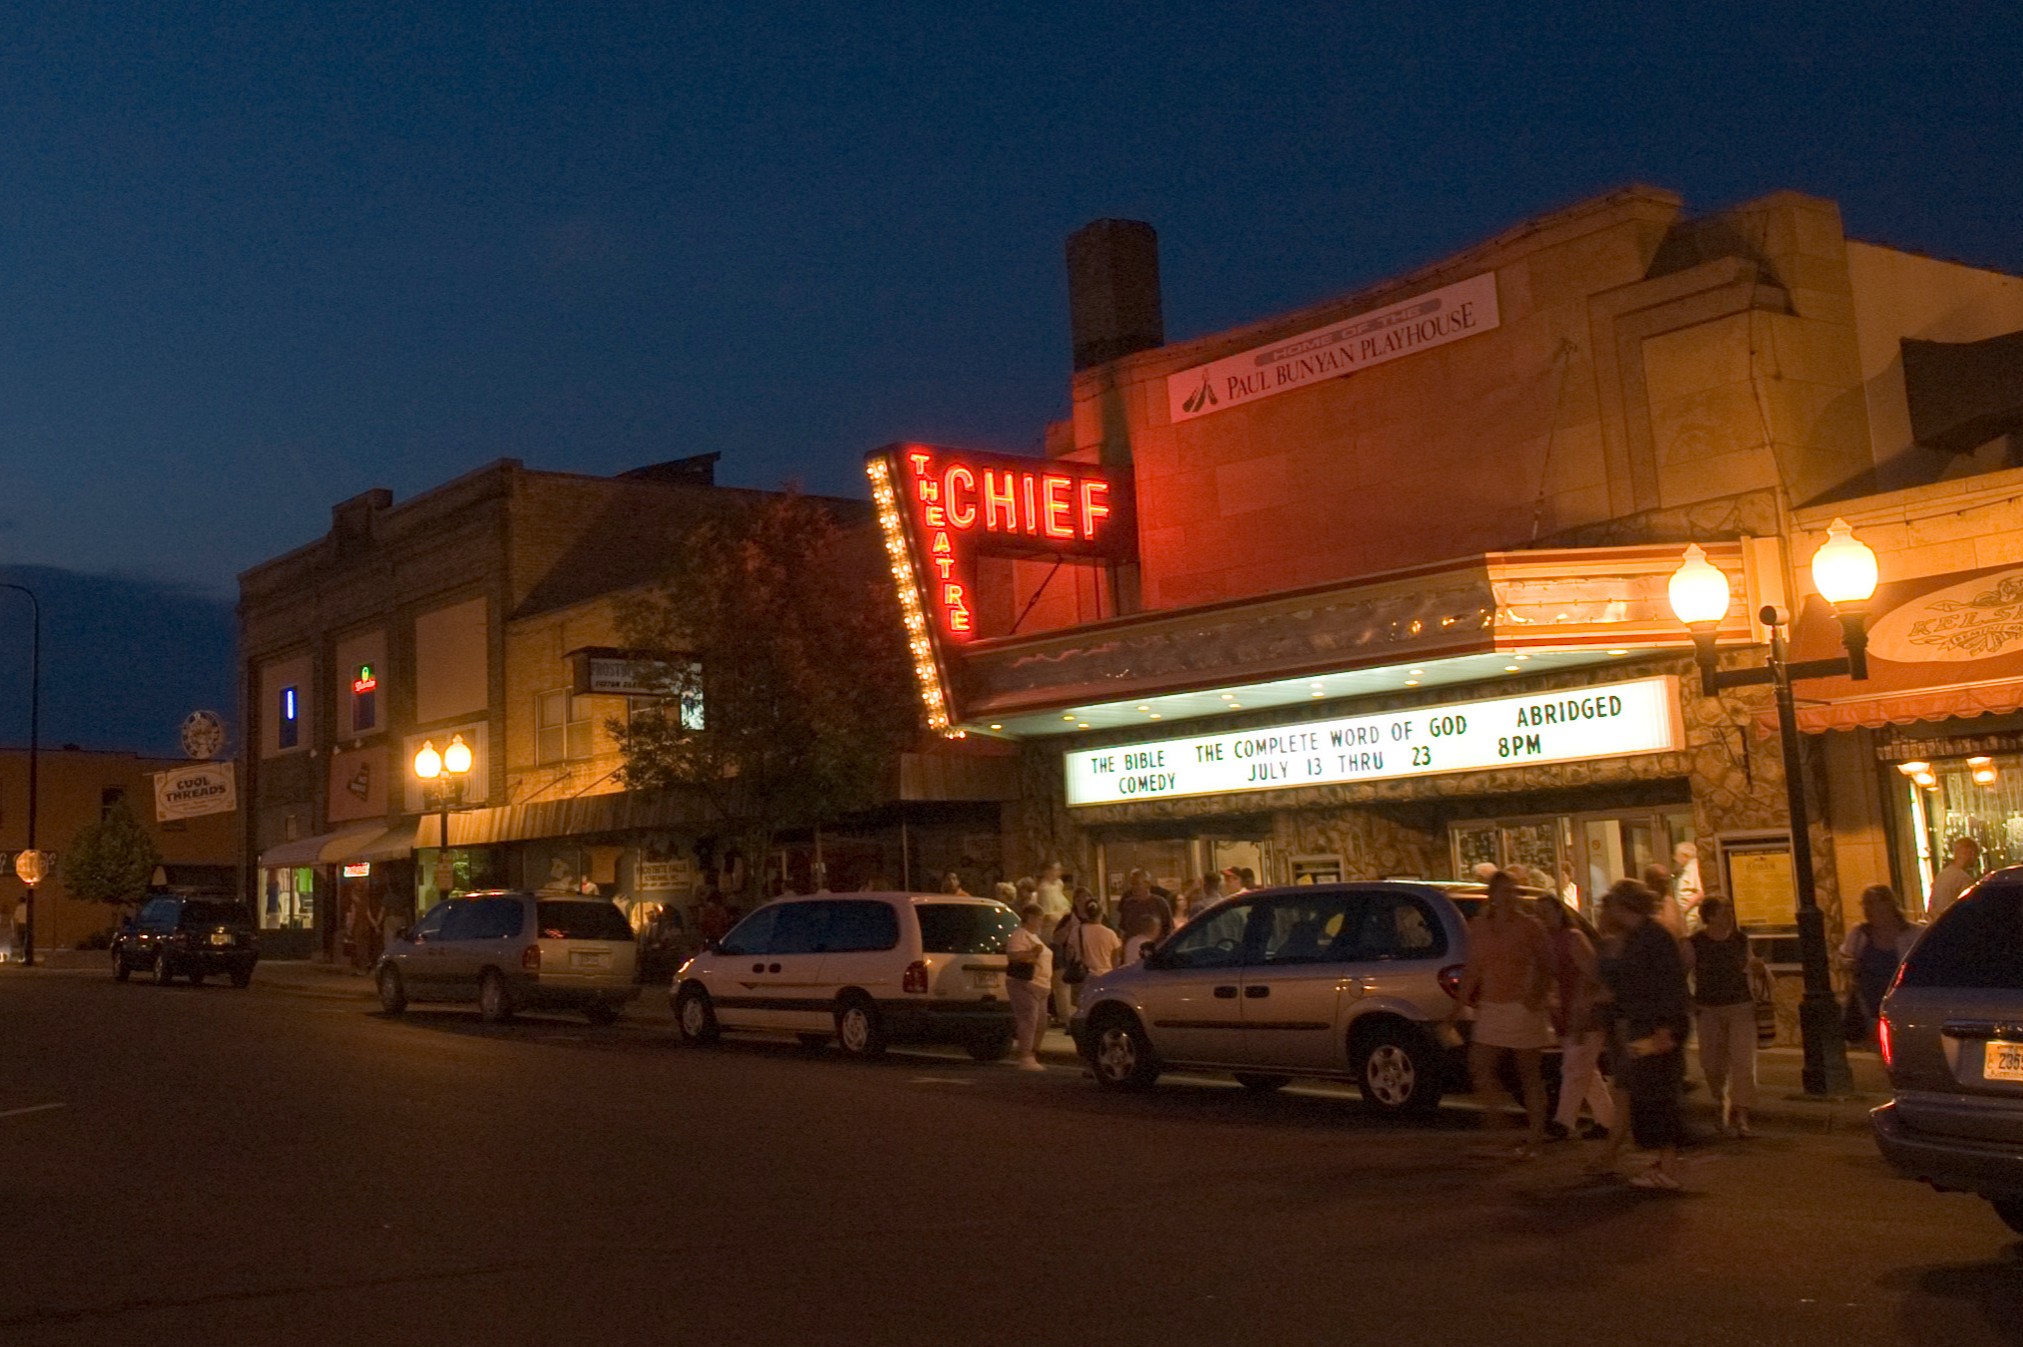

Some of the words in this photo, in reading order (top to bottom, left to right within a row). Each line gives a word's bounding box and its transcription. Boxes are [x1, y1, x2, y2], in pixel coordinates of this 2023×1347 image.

[1227, 372, 1271, 401] PAUL
[1275, 343, 1354, 385] BUNYAN
[1361, 301, 1477, 361] PLAYHOUSE
[1273, 333, 1333, 361] HOME
[1341, 323, 1371, 340] OF
[1377, 305, 1421, 327] THE
[945, 464, 1111, 541] CHIEF
[910, 453, 971, 632] THEATRE
[1091, 756, 1115, 774] THE
[1124, 750, 1165, 771] BIBLE
[1195, 743, 1224, 763] THE
[1234, 732, 1319, 759] COMPLETE
[1330, 725, 1380, 748] WORD
[1391, 721, 1413, 742] OF
[1429, 715, 1468, 738] GOD
[1517, 695, 1622, 728] ABRIDGED
[1118, 772, 1176, 795] COMEDY
[1248, 760, 1289, 782] JULY
[1307, 757, 1323, 776] 13
[1338, 751, 1384, 773] THRU
[1412, 745, 1432, 767] 23
[1498, 733, 1542, 758] 8PM
[166, 784, 227, 802] THREADS
